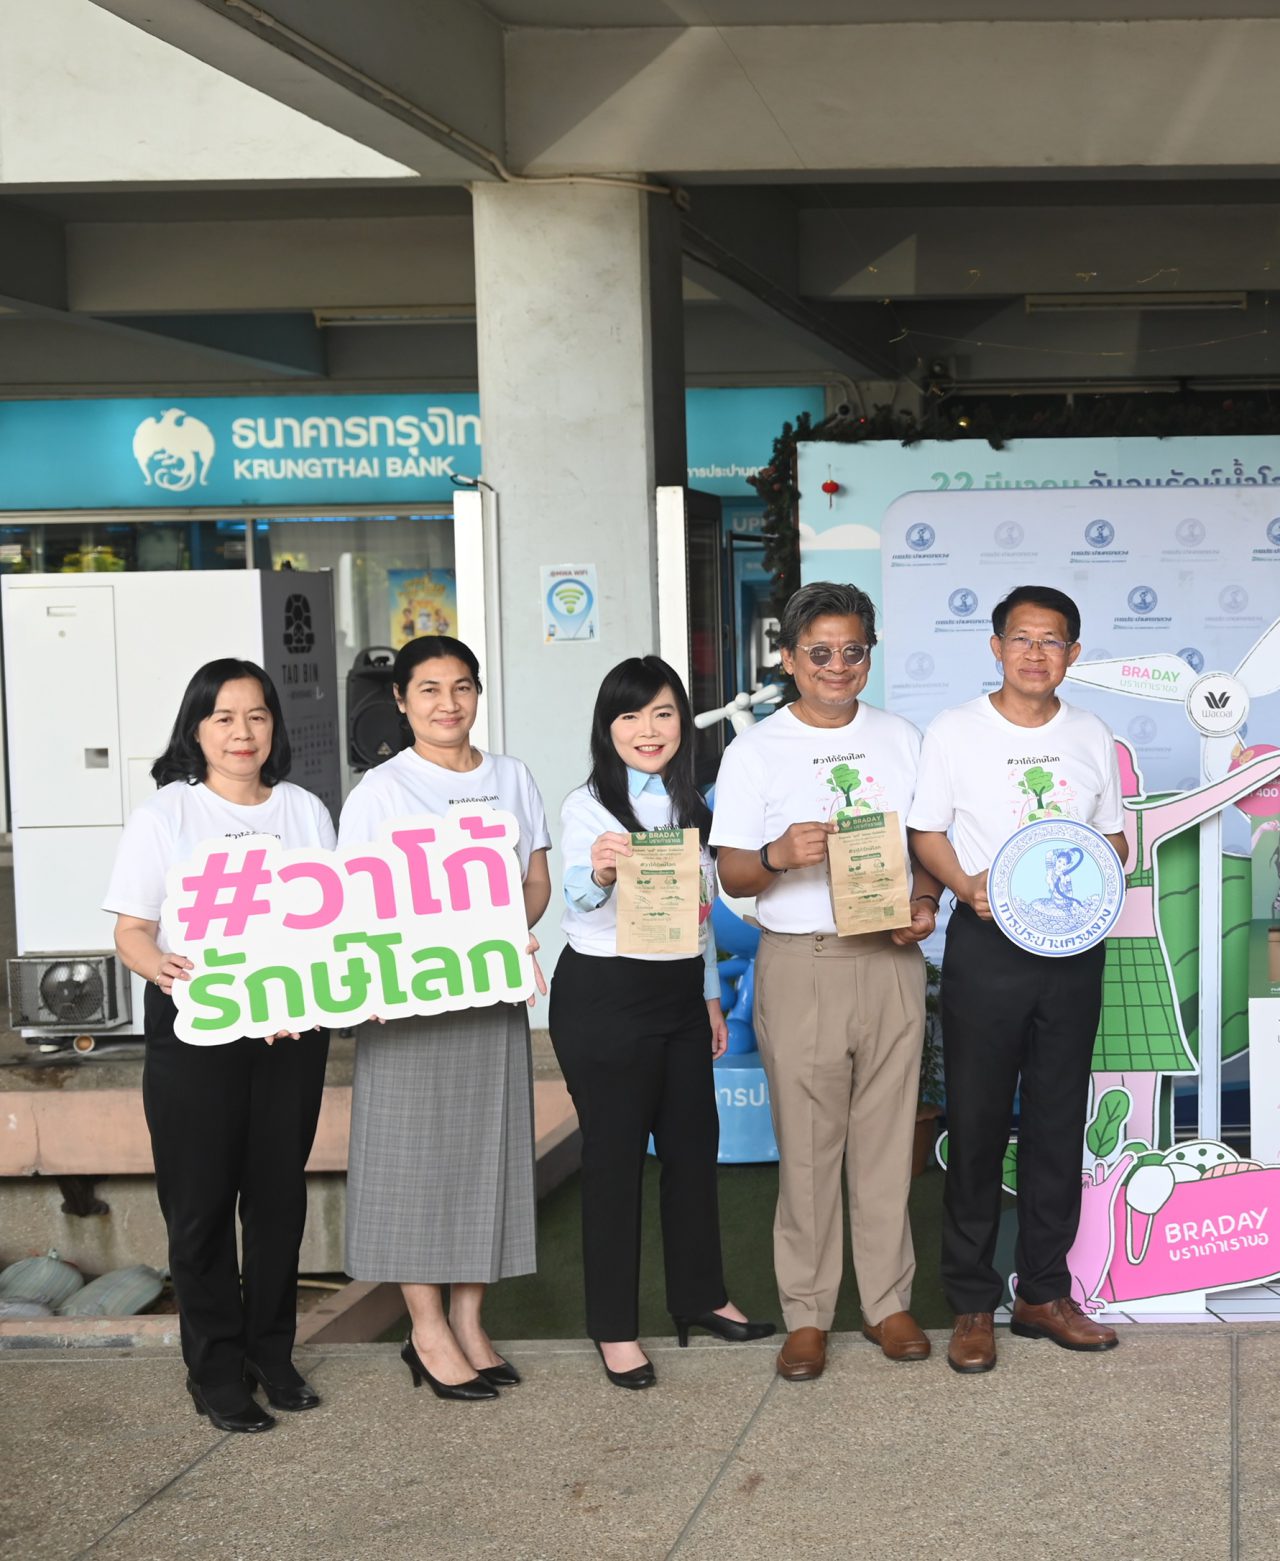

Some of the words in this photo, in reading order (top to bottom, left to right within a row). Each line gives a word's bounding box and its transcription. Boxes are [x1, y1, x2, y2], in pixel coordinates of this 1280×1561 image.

[234, 458, 379, 480] KRUNGTHAI
[386, 456, 454, 478] BANK
[1121, 665, 1180, 682] BRADAY
[812, 752, 866, 766] #วาโก้รักษ์โลก
[1006, 755, 1061, 766] #วาโก้รักษ์โลก
[1256, 787, 1279, 798] 400
[176, 815, 511, 942] #วาโก้
[187, 931, 523, 1031] รักษ์โลก
[1164, 1206, 1269, 1245] BRADAY
[1168, 1231, 1270, 1262] บราเก่าเราขอ
